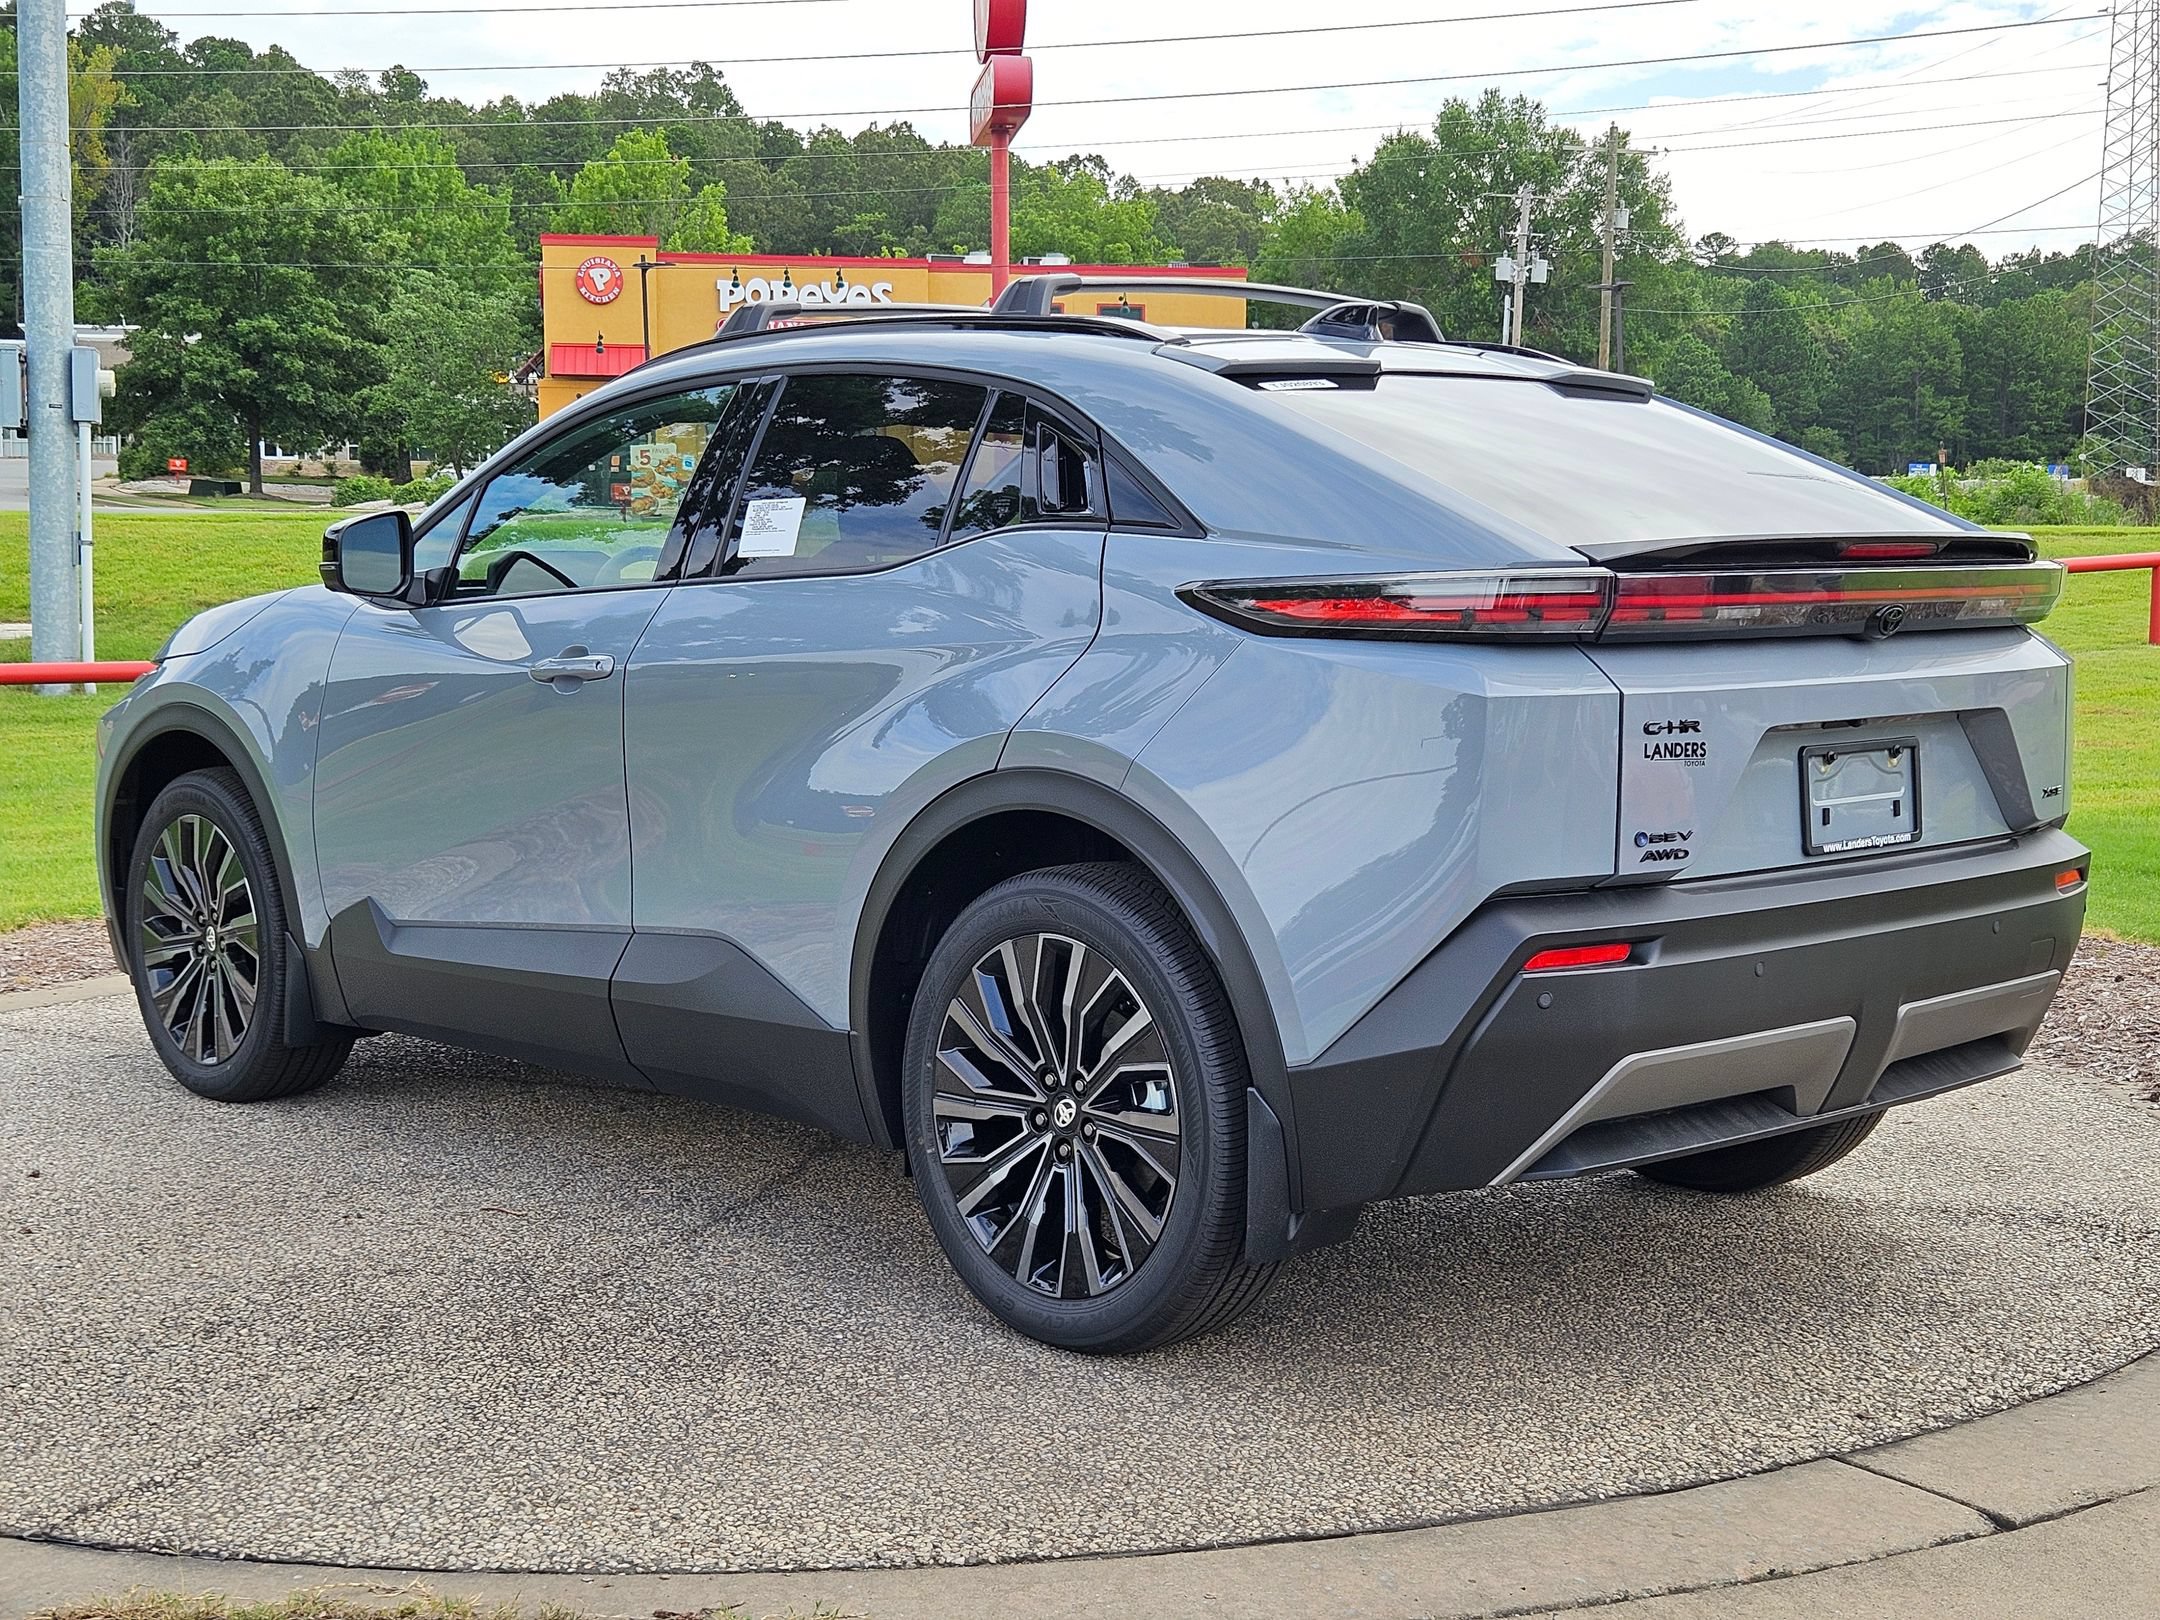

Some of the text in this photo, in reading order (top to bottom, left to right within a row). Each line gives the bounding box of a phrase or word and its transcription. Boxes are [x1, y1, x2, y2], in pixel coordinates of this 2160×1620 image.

[577, 257, 621, 277] LOUISIANA
[588, 268, 612, 291] P
[580, 286, 620, 302] KITCHEN
[1643, 742, 1707, 760] LANDERS
[1683, 760, 1706, 768] TOYOTA
[1822, 833, 1912, 853] www.LandersToyota.com
[1639, 848, 1690, 862] AWD
